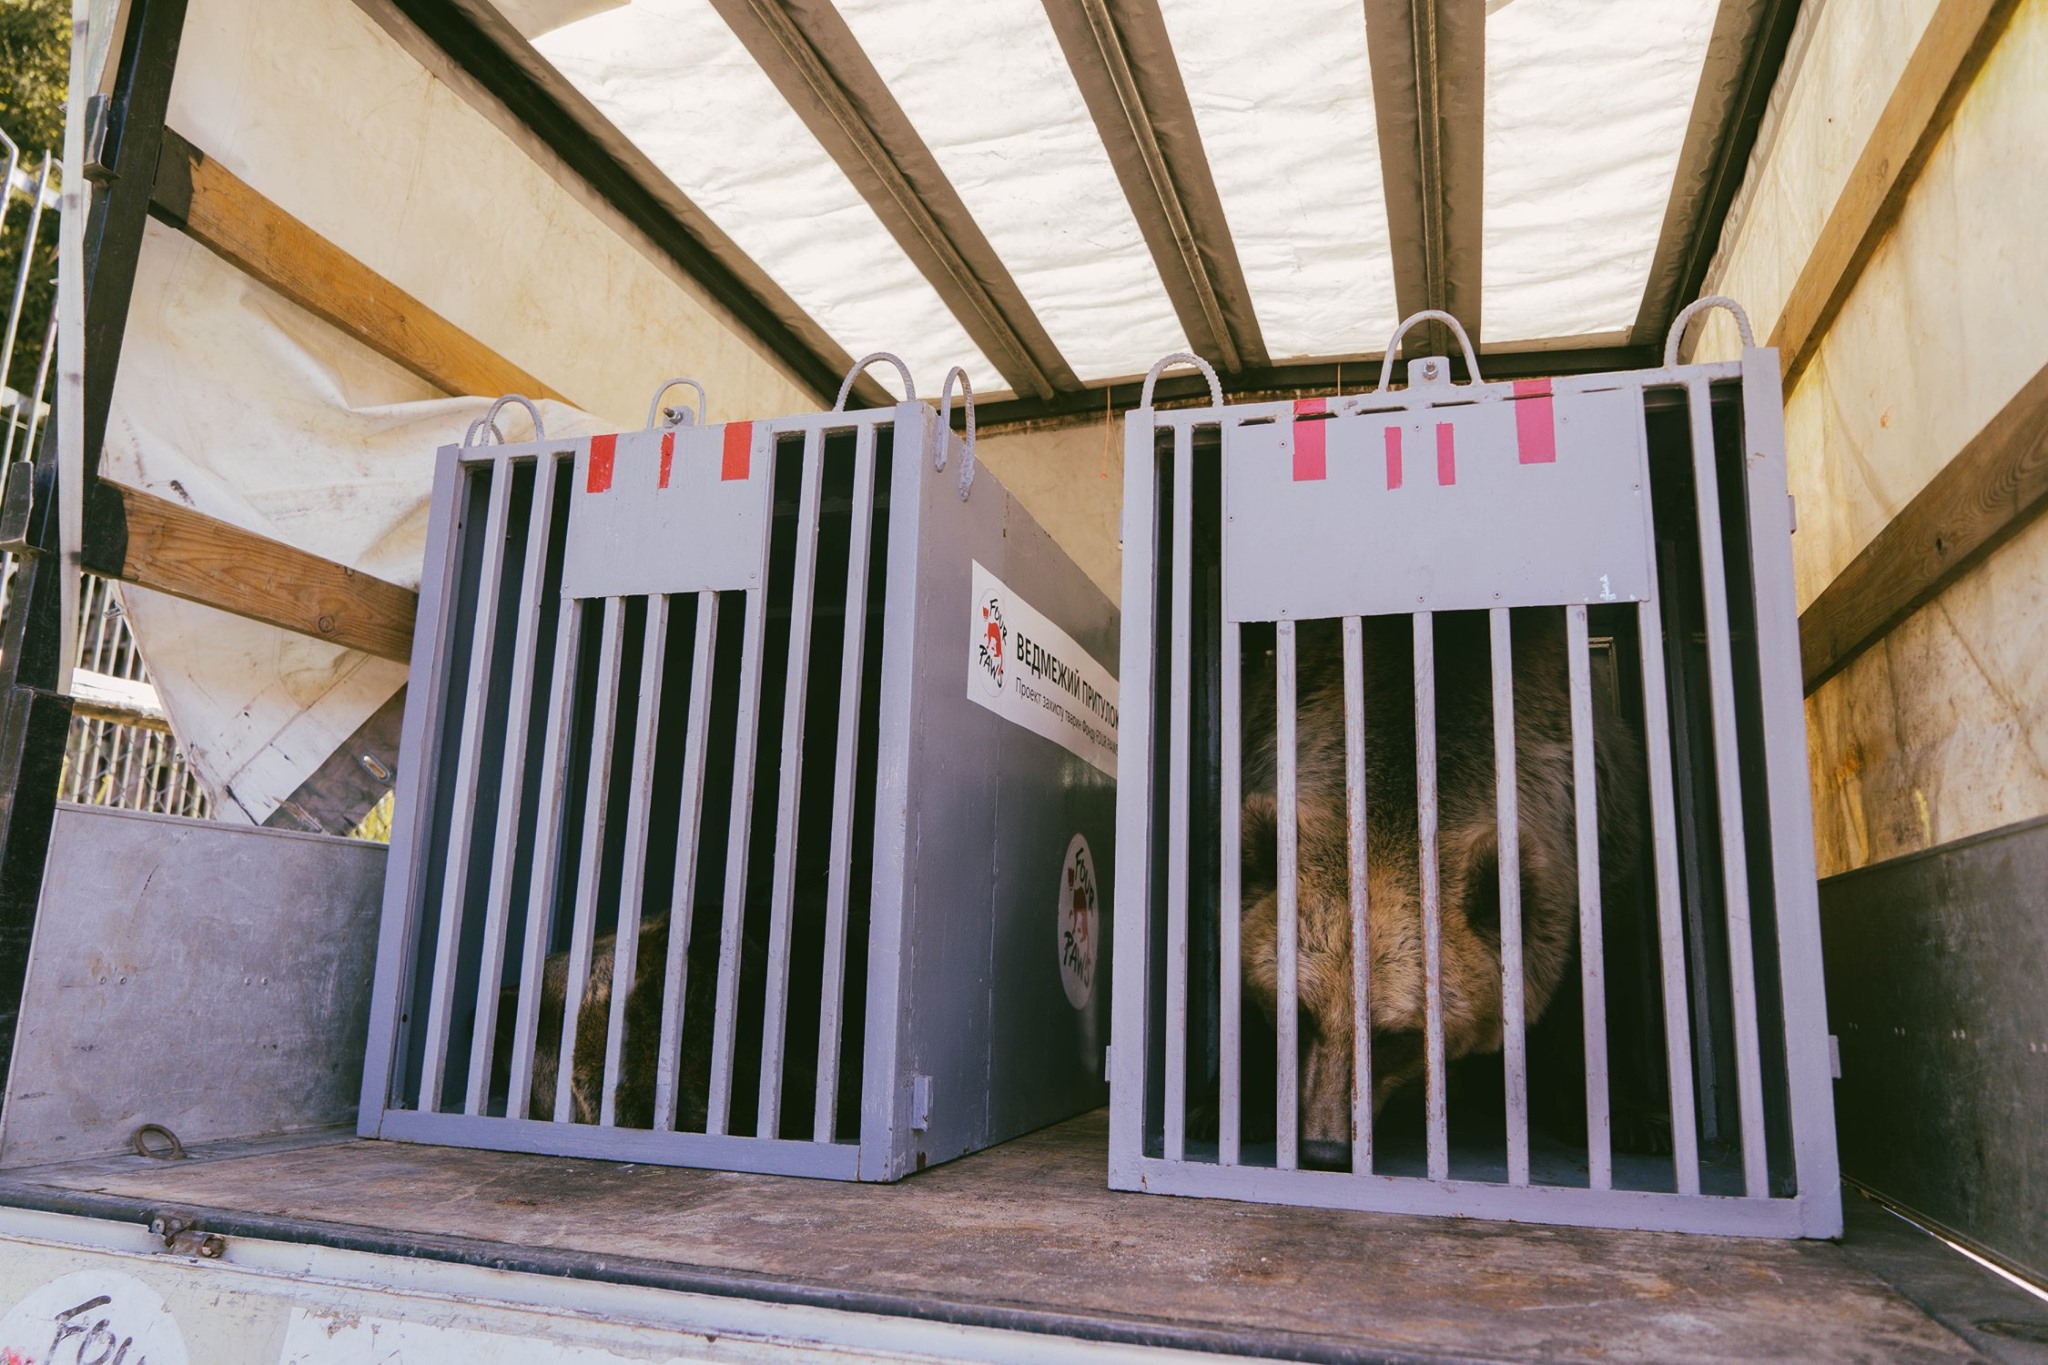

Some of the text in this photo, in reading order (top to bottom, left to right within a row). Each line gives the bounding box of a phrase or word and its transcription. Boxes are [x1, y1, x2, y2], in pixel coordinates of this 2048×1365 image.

[989, 598, 1008, 647] FOUR
[979, 644, 1004, 688] PAWS
[1016, 631, 1081, 701] ВЕДМЕЖИЙ
[1015, 676, 1042, 704] Проект
[1042, 695, 1065, 723] захисту
[1065, 709, 1082, 731] тварин
[1074, 847, 1095, 917] FOUR
[1063, 930, 1090, 989] PAWS
